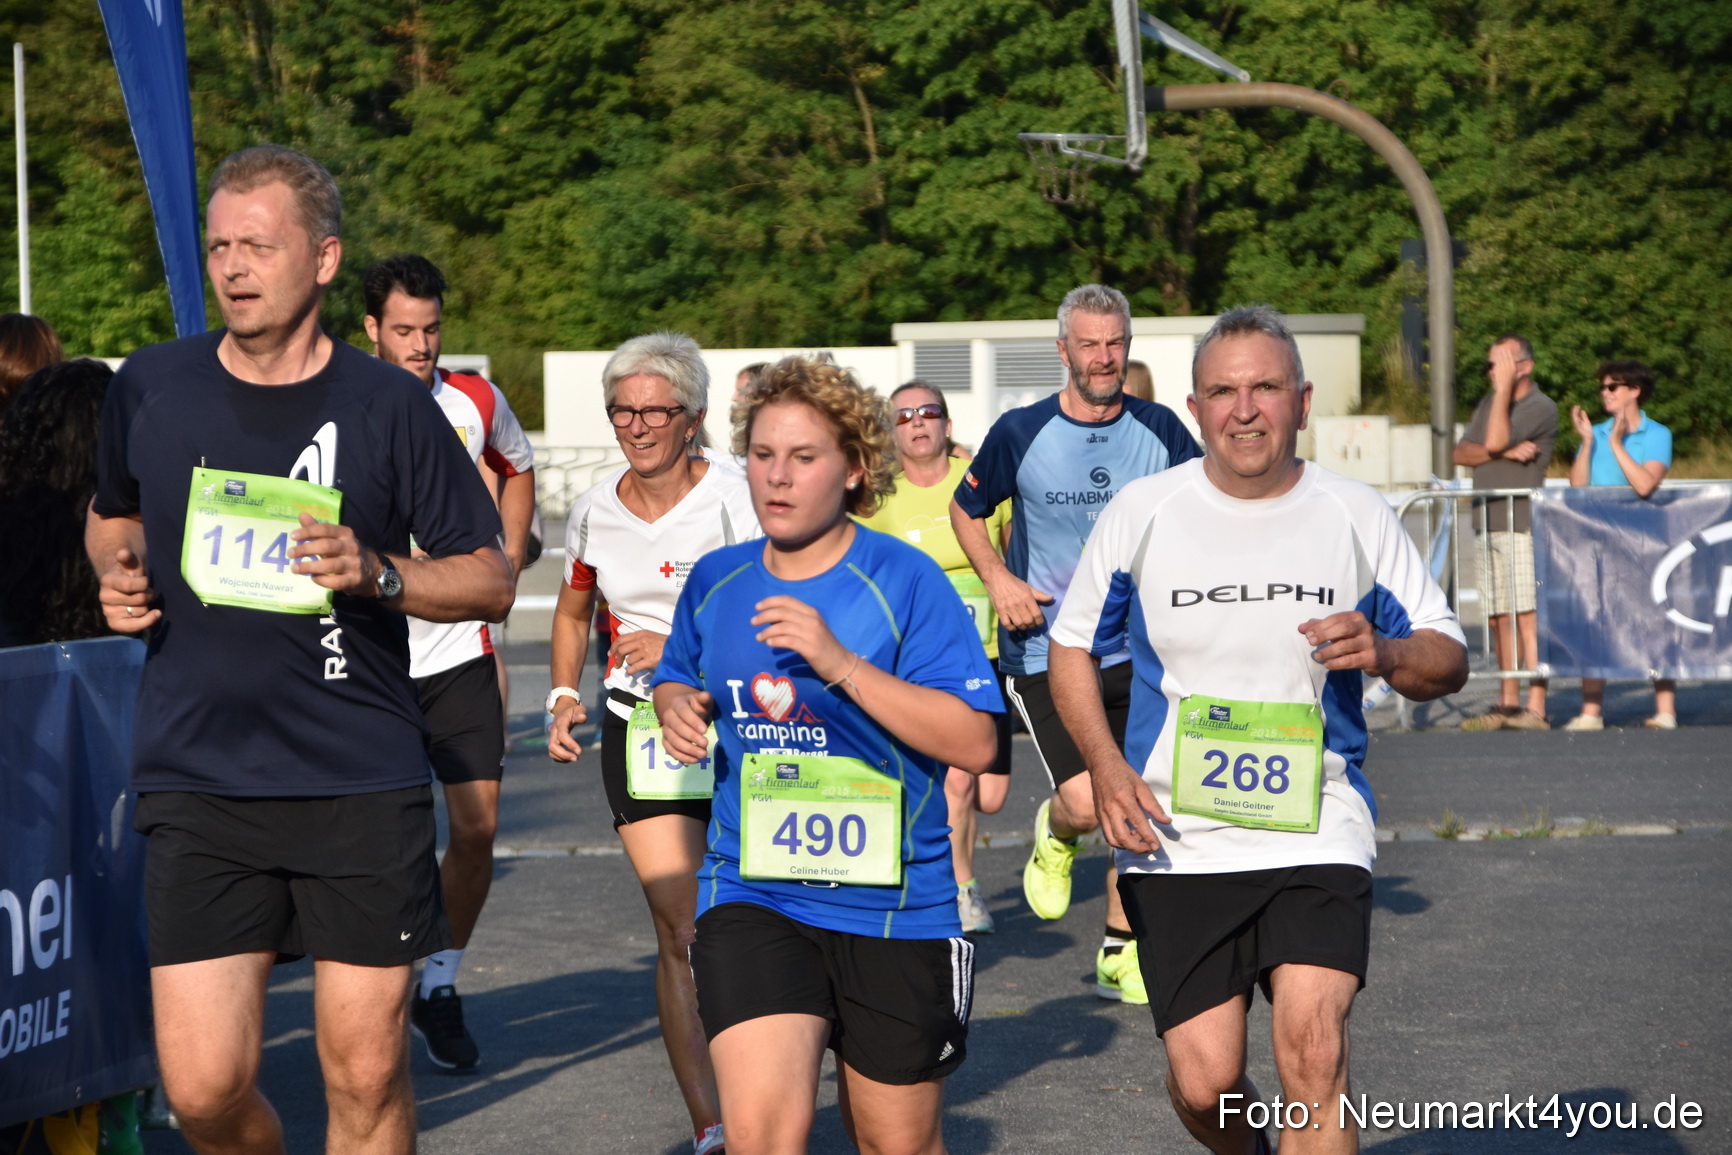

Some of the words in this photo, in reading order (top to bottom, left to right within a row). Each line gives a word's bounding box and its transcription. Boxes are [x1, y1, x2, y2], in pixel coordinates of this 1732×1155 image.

[213, 492, 265, 507] firmenlauf
[266, 503, 292, 515] 2015
[219, 577, 261, 589] Wojciech
[262, 582, 294, 593] Nawrat
[1171, 583, 1334, 607] DELPHI
[726, 679, 749, 719] I
[1198, 716, 1250, 731] firmenlauf
[736, 721, 827, 748] camping
[1250, 728, 1277, 738] 2015
[1201, 749, 1290, 795] 268
[765, 777, 820, 789] firmenlauf
[821, 786, 851, 796] 2015
[1214, 797, 1241, 808] Daniel
[1242, 801, 1275, 811] Geitner
[772, 812, 867, 857] 490
[789, 866, 819, 876] Celine
[820, 867, 849, 876] Huber
